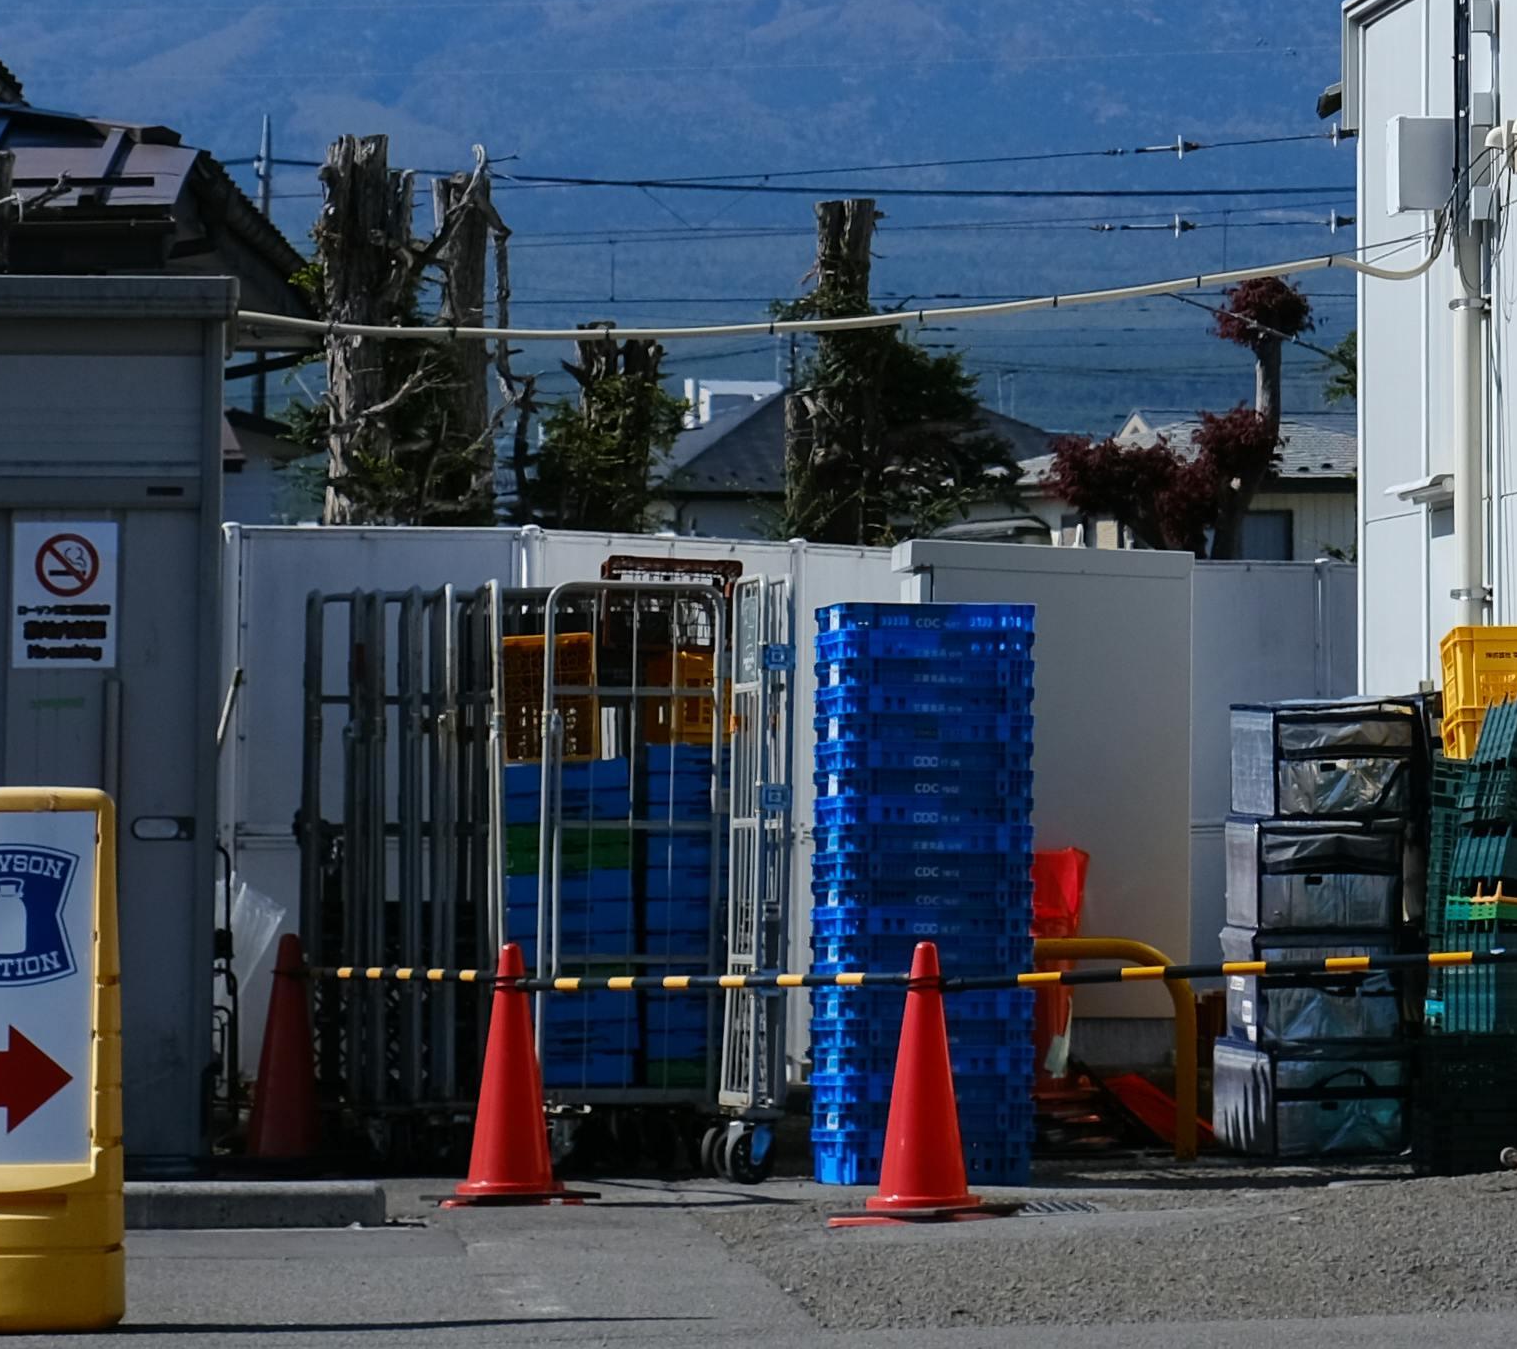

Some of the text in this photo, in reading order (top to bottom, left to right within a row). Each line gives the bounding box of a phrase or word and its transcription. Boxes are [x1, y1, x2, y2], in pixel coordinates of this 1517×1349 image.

[915, 617, 941, 629] CDC
[913, 756, 939, 768] CDC
[913, 783, 939, 794] CDC
[913, 811, 939, 823] CDC
[913, 866, 939, 878] CDC
[914, 895, 940, 906] CDC
[913, 922, 939, 934] CDC
